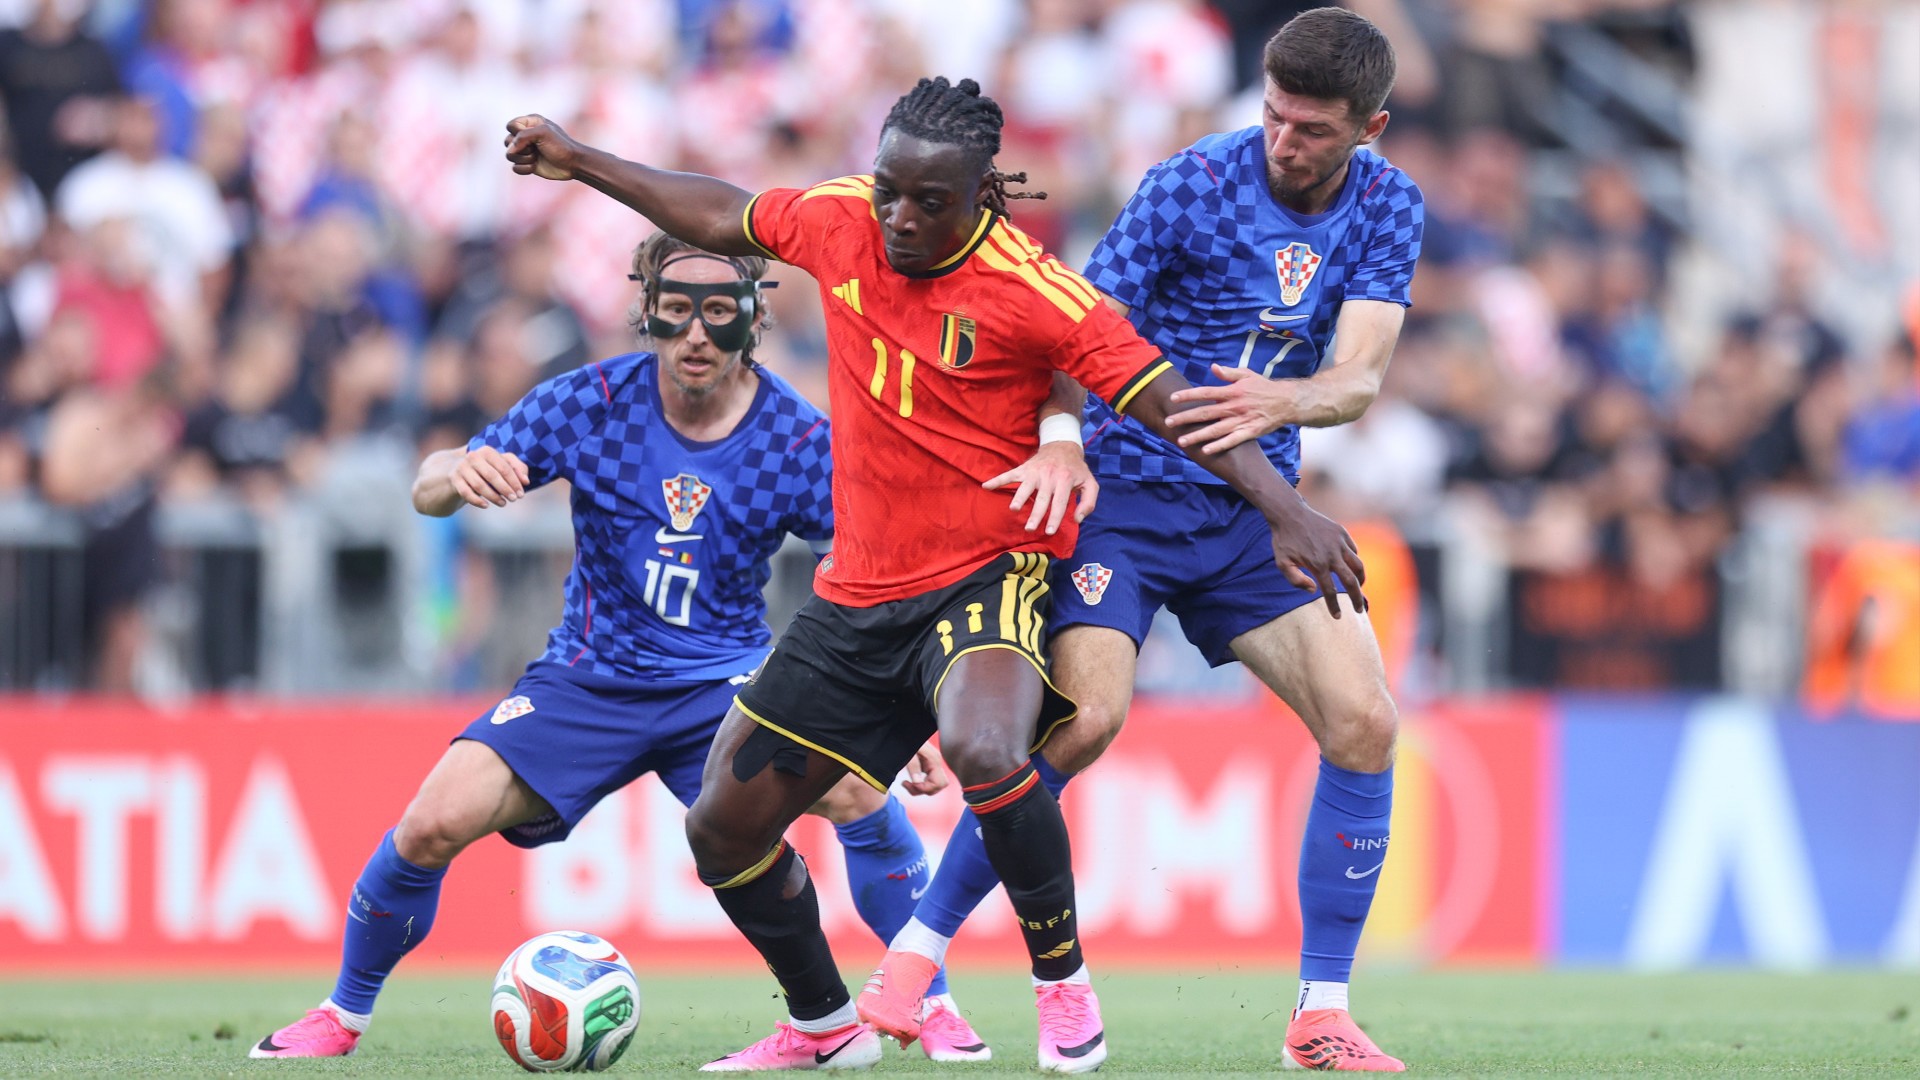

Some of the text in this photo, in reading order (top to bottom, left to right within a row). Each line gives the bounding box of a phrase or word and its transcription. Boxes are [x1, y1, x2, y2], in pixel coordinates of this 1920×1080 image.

[869, 337, 916, 418] 11
[1238, 329, 1305, 379] 17
[643, 558, 700, 627] 10
[1352, 832, 1391, 850] HNS
[353, 886, 371, 911] NS
